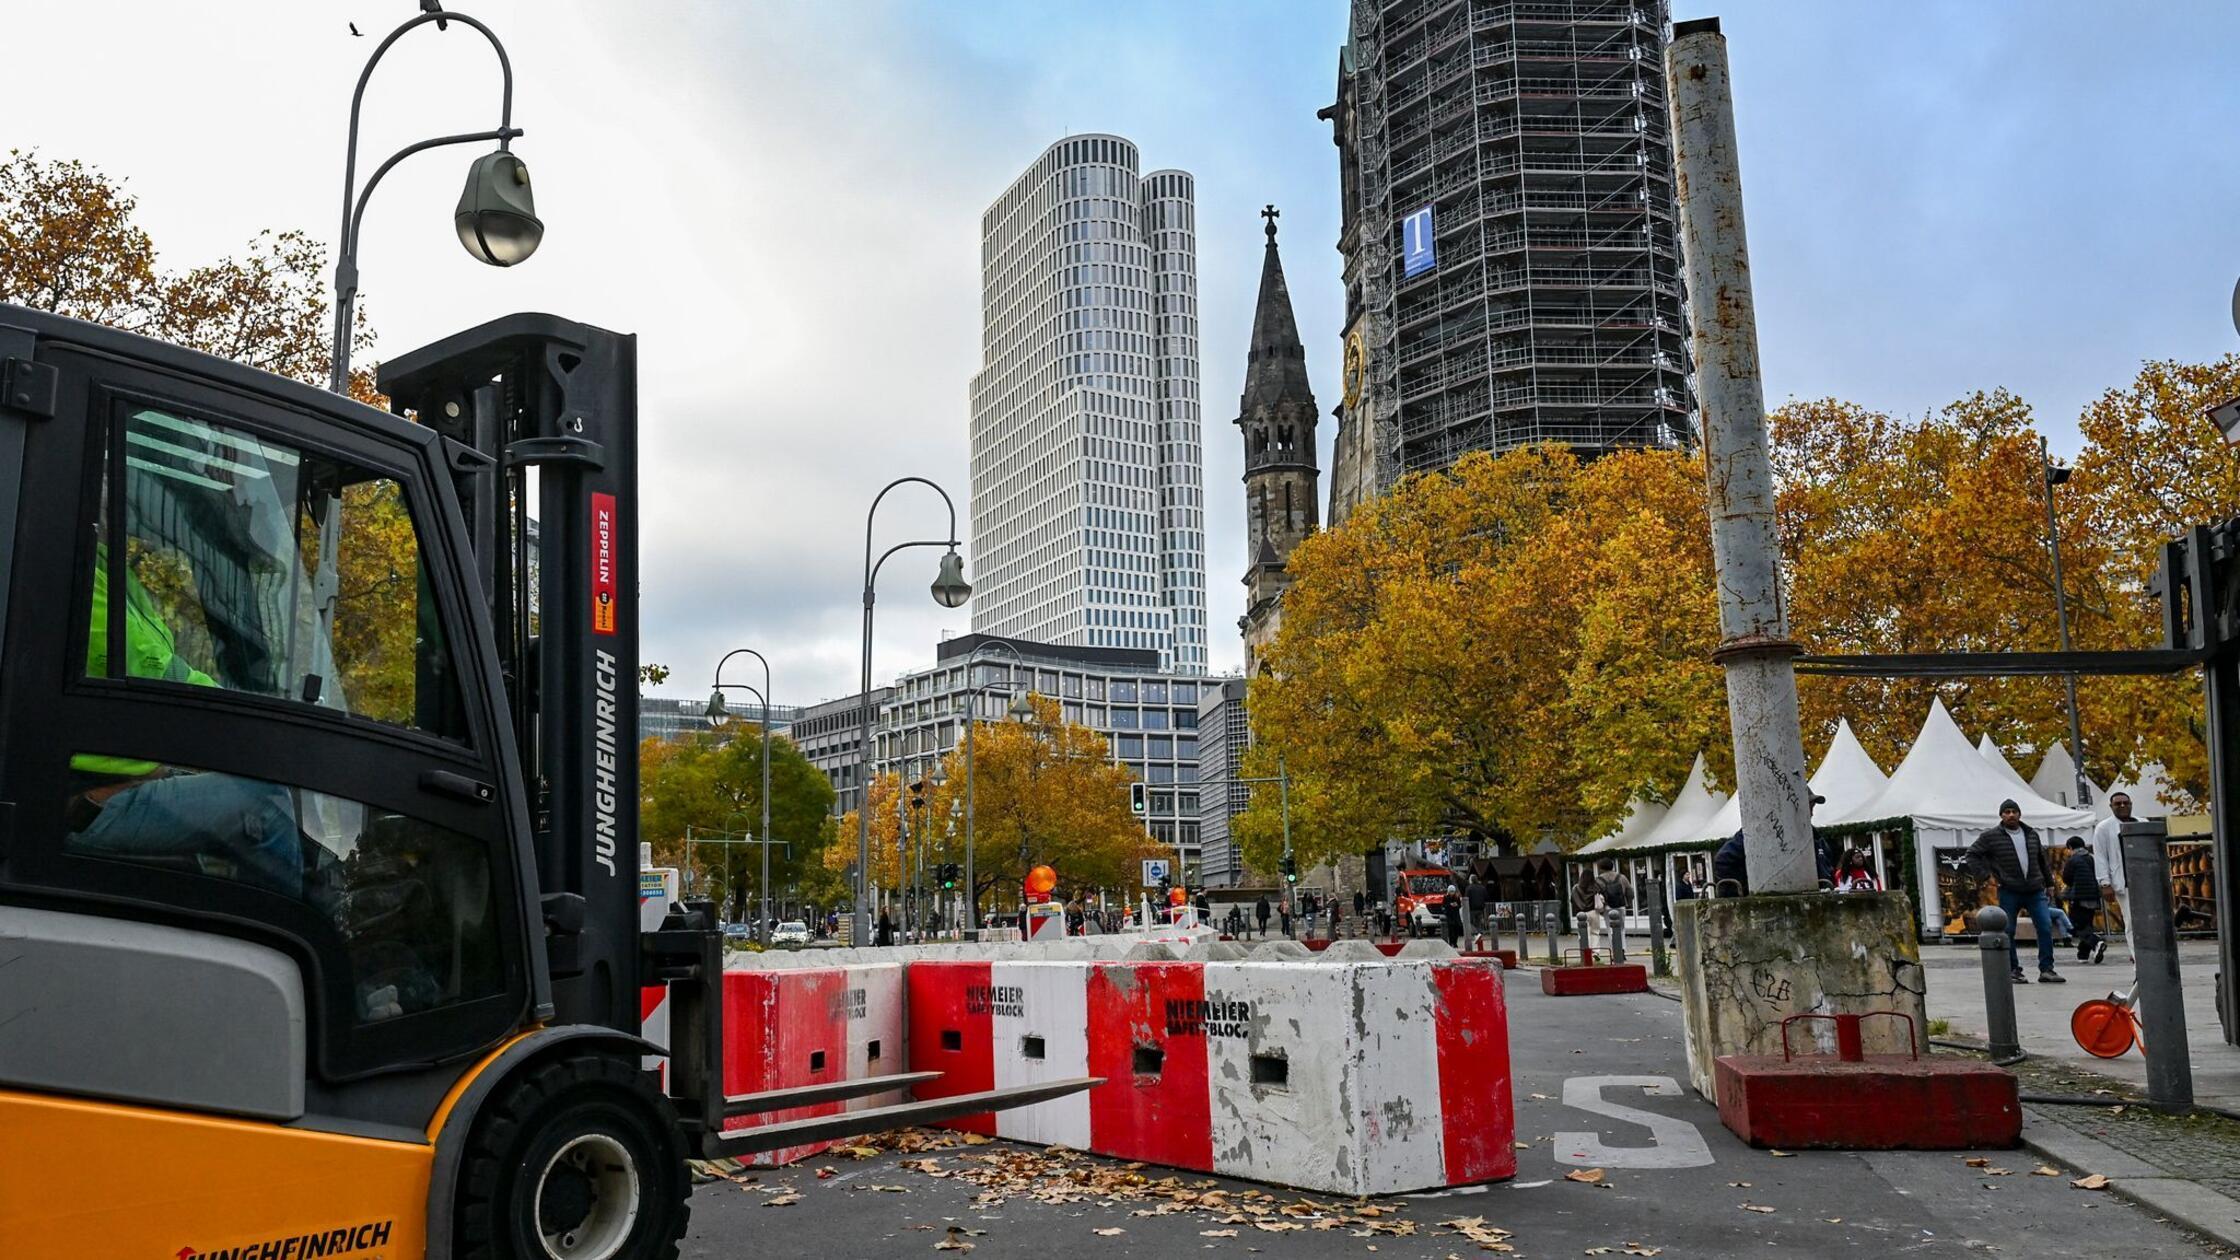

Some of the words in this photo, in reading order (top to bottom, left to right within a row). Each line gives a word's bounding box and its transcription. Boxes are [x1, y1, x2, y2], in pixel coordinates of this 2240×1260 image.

[1404, 207, 1431, 257] T
[599, 510, 609, 583] ZEPPELIN
[595, 649, 616, 877] JUNGHEINRICH
[967, 985, 1024, 1003] NIEMEIER
[1166, 1000, 1250, 1022] NIEMEIER
[1553, 1075, 1715, 1168] S
[187, 1221, 392, 1260] NGHEINRICH
